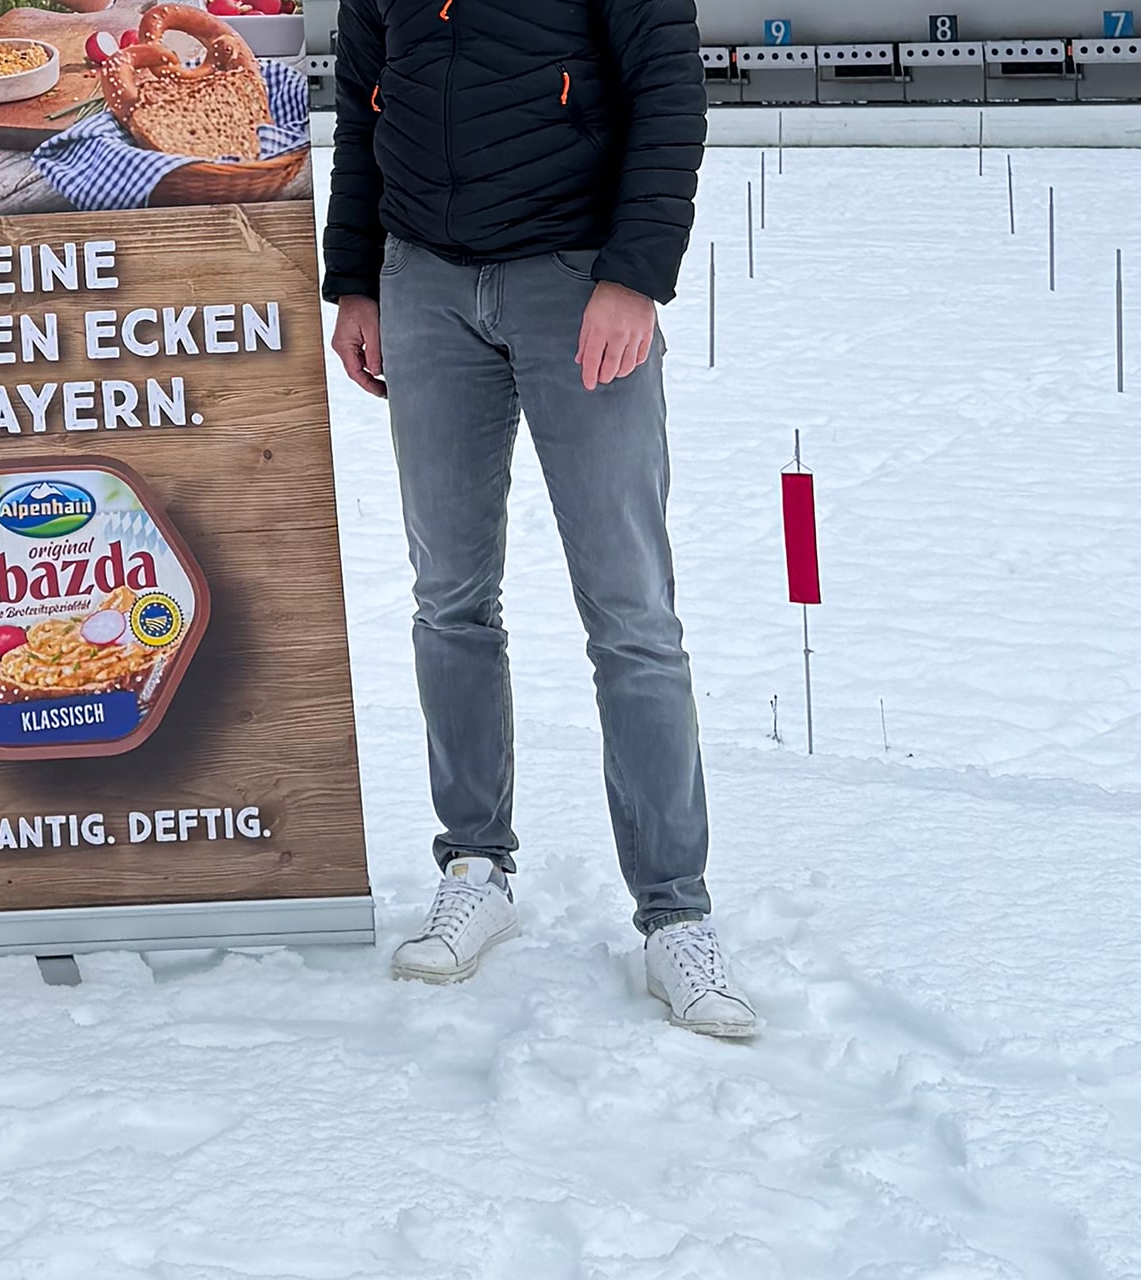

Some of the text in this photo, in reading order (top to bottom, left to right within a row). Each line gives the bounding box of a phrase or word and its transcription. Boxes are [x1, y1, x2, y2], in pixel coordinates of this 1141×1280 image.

[771, 21, 786, 44] 9
[936, 16, 951, 41] 8
[1110, 12, 1127, 37] 7
[85, 301, 282, 360] ECKEN
[0, 498, 92, 520] Alpenhain
[28, 536, 95, 561] original
[21, 703, 105, 732] KLASSISCH
[128, 806, 272, 844] DEFTIG.
